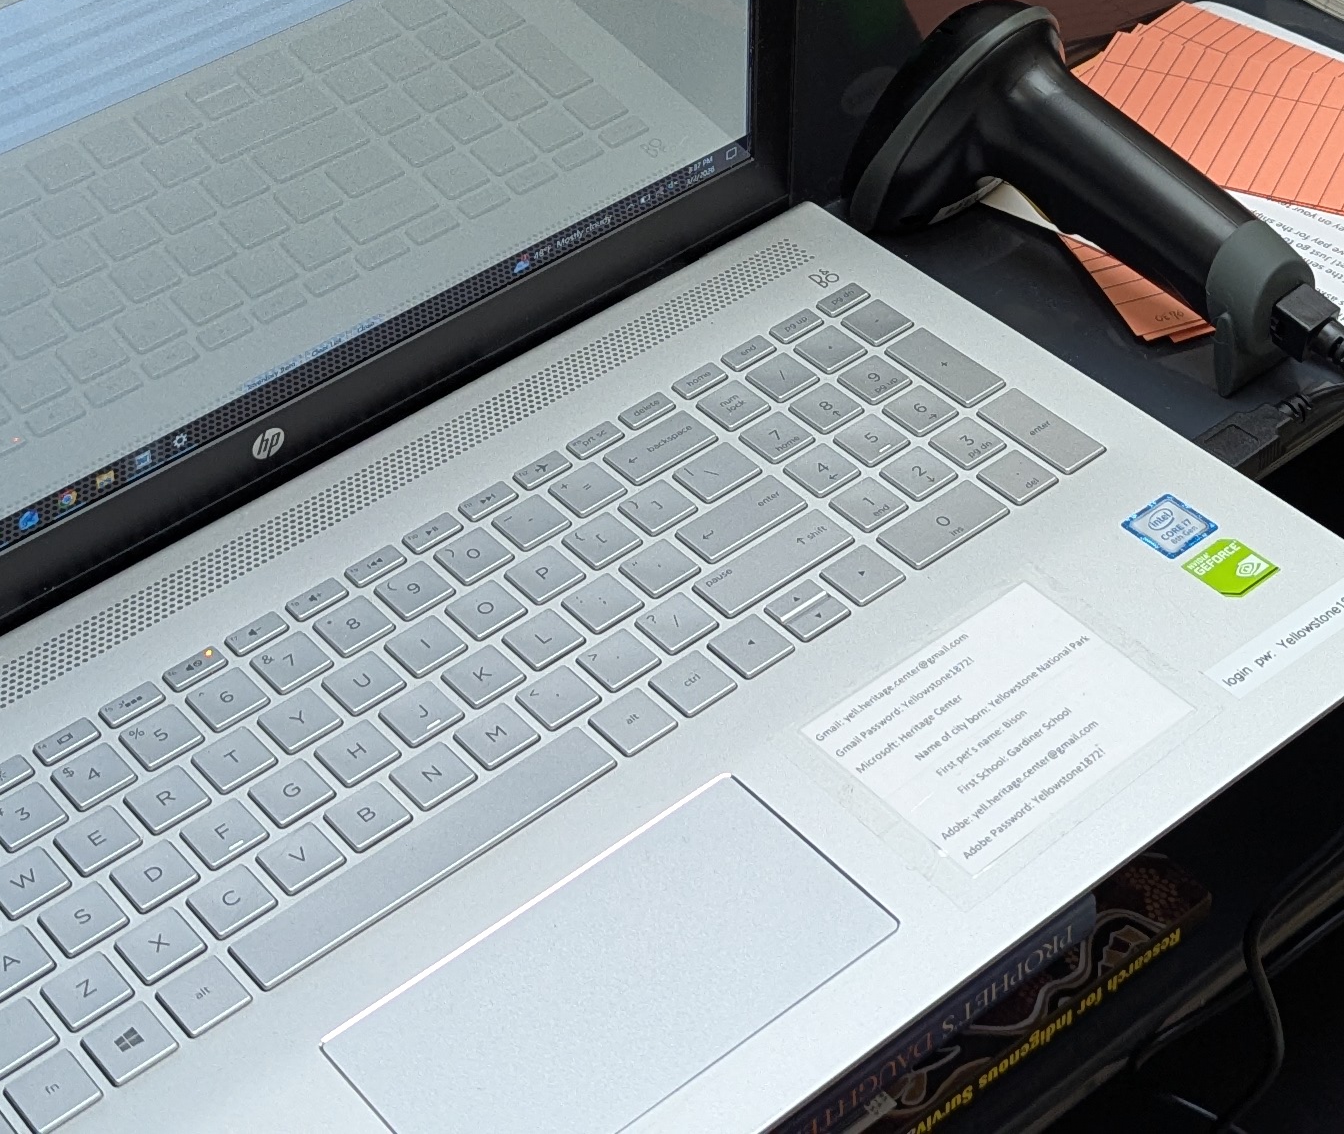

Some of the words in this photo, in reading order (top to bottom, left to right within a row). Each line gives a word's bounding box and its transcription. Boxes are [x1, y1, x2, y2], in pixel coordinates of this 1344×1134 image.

[556, 229, 584, 249] Mostly
[1160, 523, 1182, 542] CORE
[1194, 543, 1241, 576] GEFORCE
[815, 719, 845, 742] Gmail:
[843, 634, 969, 723] yell.heritage.center@gmail.com
[835, 735, 863, 758] Gmail
[859, 706, 904, 739] Password:
[900, 656, 975, 708] Yellowstone1872!
[914, 740, 943, 761] Name
[941, 731, 952, 742] of
[951, 721, 969, 735] city
[964, 706, 991, 725] born:
[987, 671, 1039, 708] Yellowstone
[1035, 646, 1073, 673] National
[1068, 635, 1090, 650] Park
[1221, 666, 1253, 691] login
[1254, 650, 1277, 668] pw:
[855, 740, 901, 774] Microsoft:
[897, 714, 935, 743] Heritage
[933, 694, 963, 716] Center
[935, 760, 958, 777] First
[977, 727, 1005, 749] name:
[1001, 710, 1028, 729] Bison
[956, 774, 979, 795] First
[975, 756, 1009, 781] School:
[1006, 728, 1044, 757] Gardiner
[1041, 706, 1072, 731] School
[941, 816, 973, 841] Adobe:
[971, 721, 1099, 820] yell.heritage.center@gmail.com
[963, 836, 993, 860] Adobe
[989, 802, 1035, 837] Password:
[1030, 747, 1106, 804] Yellowstone1872!
[1108, 927, 1182, 993] Research
[1078, 990, 1104, 1015] for
[978, 1008, 1074, 1090] Indigenous
